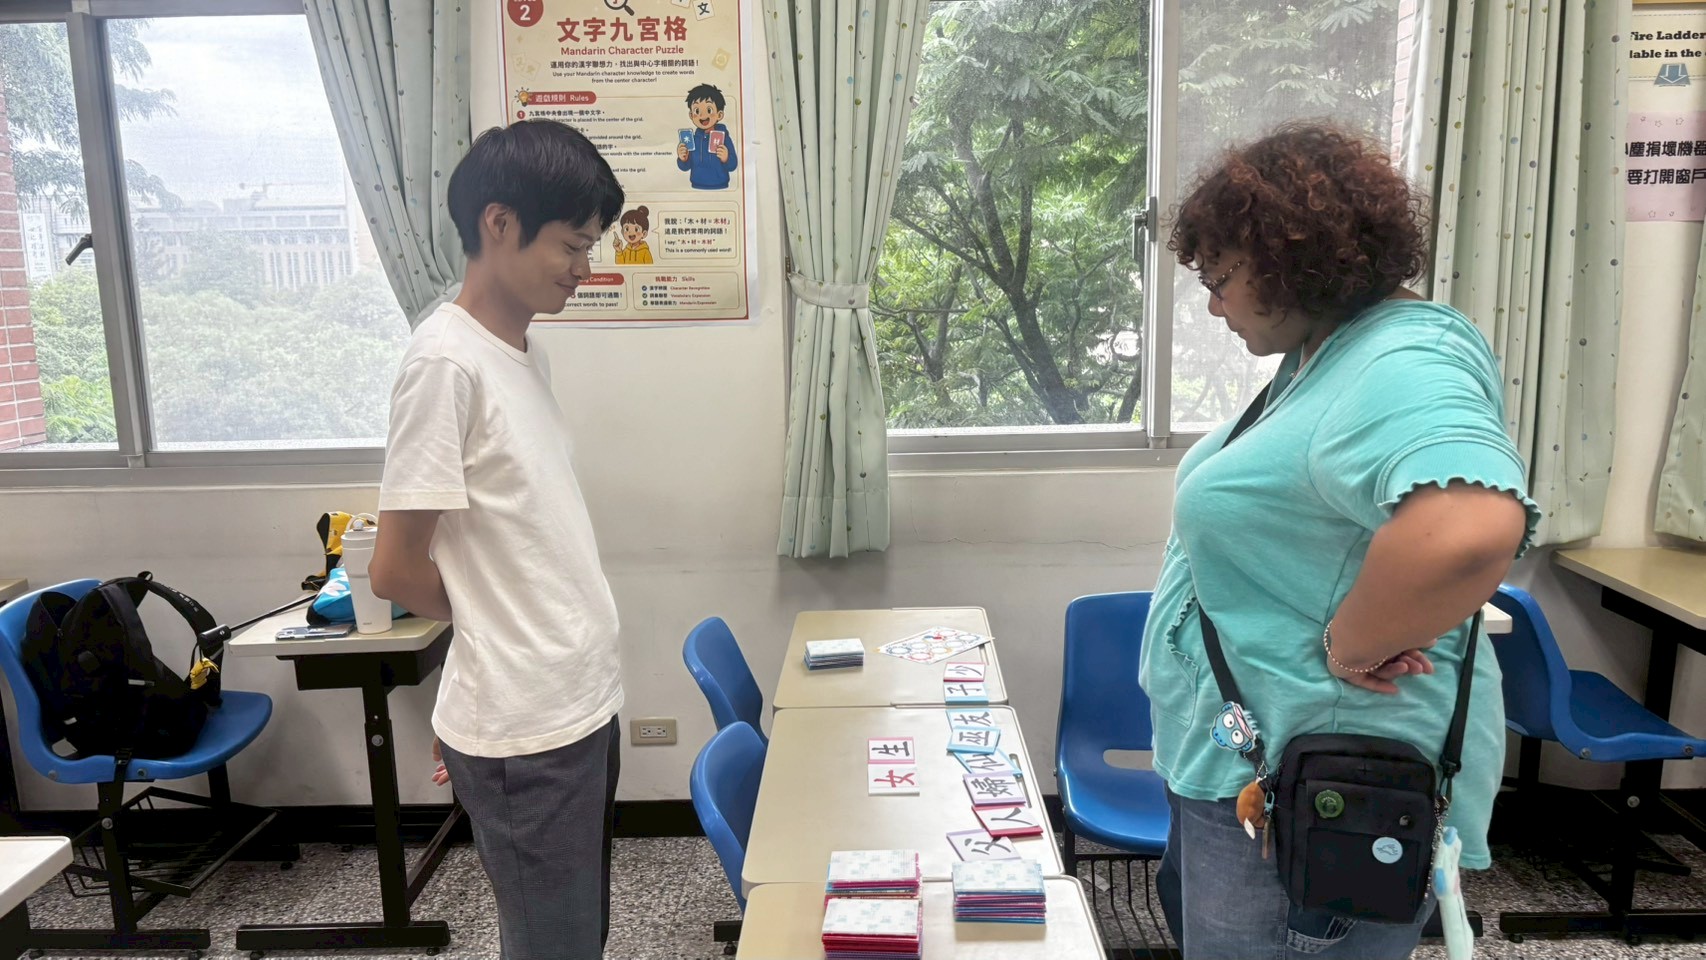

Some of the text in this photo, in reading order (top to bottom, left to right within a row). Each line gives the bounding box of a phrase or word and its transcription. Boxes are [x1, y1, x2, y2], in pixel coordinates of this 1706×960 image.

[520, 4, 531, 21] 2
[697, 2, 710, 16] 文
[556, 16, 688, 43] 文字九宮格
[560, 44, 685, 56] Mandarin Character Puzzle
[1664, 49, 1678, 58] in
[1680, 48, 1702, 58] the
[569, 94, 589, 102] Rules
[1625, 141, 1706, 157] 塵損壞機器
[947, 665, 983, 677] 少
[946, 684, 982, 696] 子
[953, 711, 992, 727] 友
[958, 730, 990, 747] 巫
[871, 741, 911, 757] 生
[873, 769, 915, 788] 女
[990, 806, 1033, 826] 人
